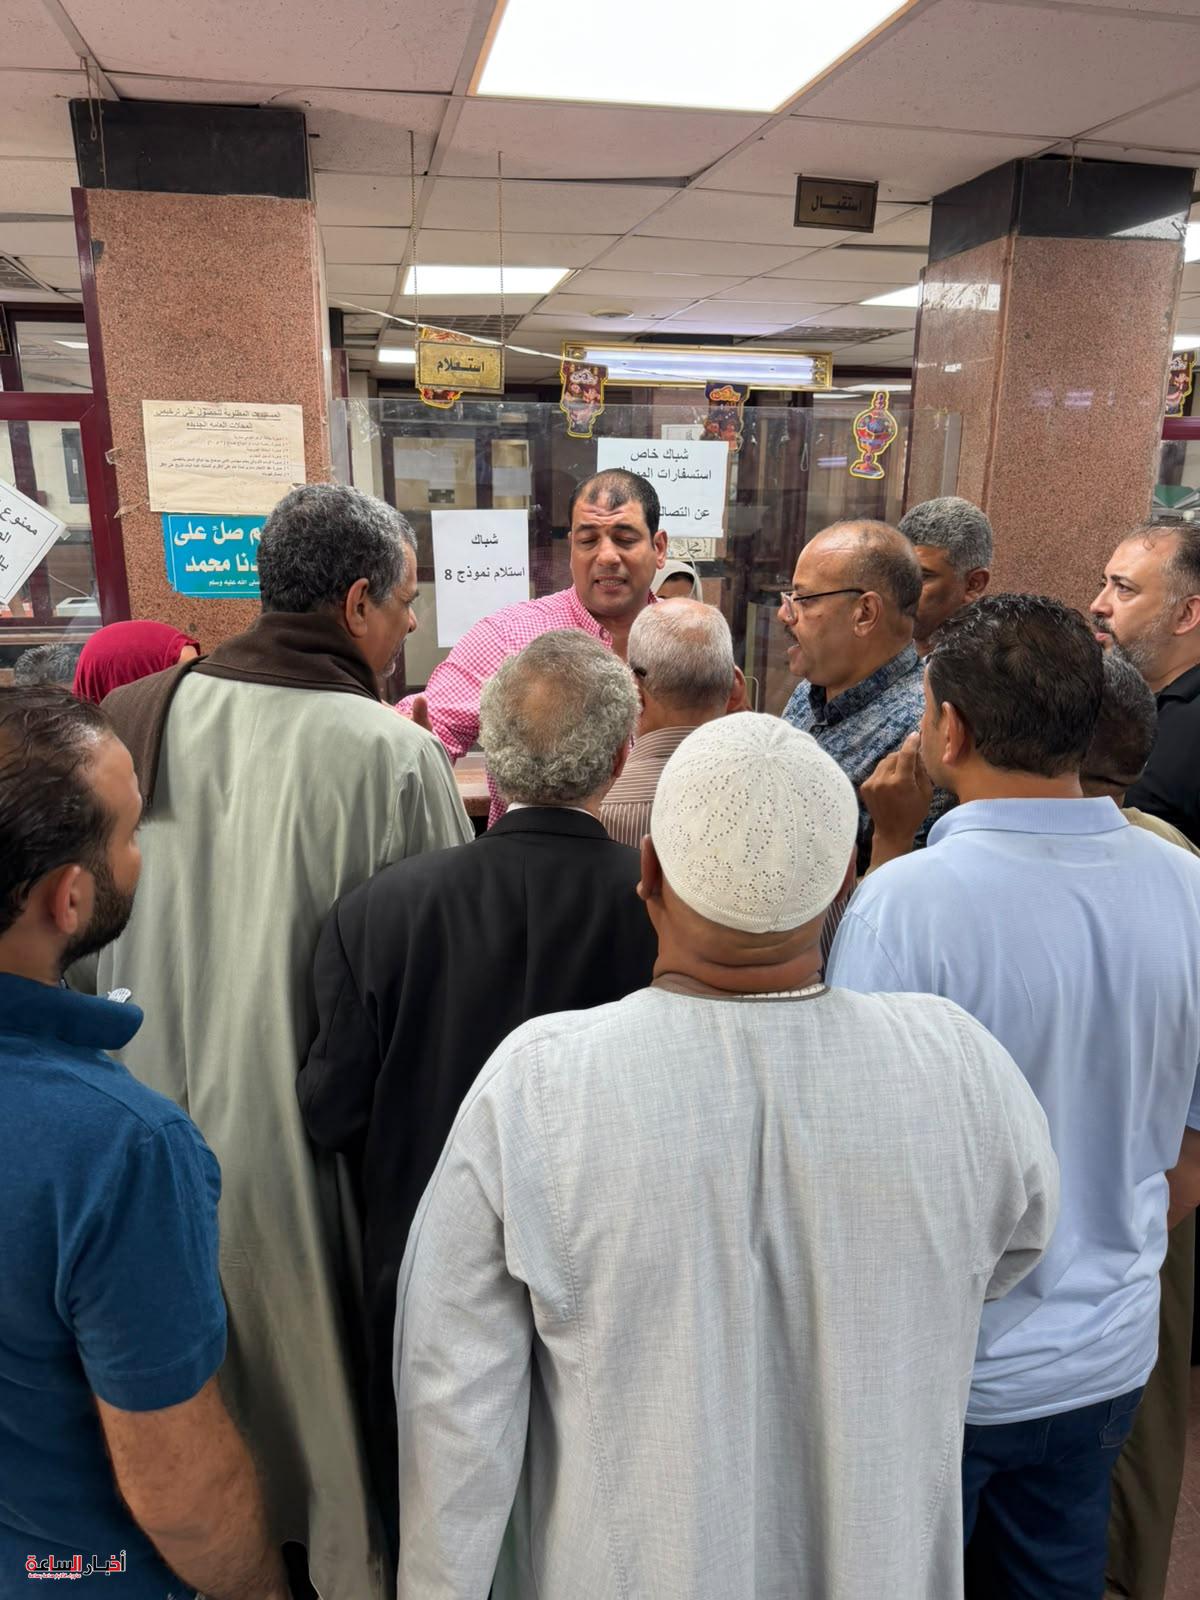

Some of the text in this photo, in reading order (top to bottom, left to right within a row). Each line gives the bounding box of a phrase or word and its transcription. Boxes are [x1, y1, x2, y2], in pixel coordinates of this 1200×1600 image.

[811, 195, 863, 214] استقبال
[436, 358, 485, 373] استعلام
[630, 448, 689, 463] شباك خاص
[659, 506, 710, 521] عن التصال
[174, 521, 207, 546] على
[471, 533, 499, 548] شباك
[185, 555, 231, 573] محمد
[444, 566, 525, 583] استلام نموذج 8
